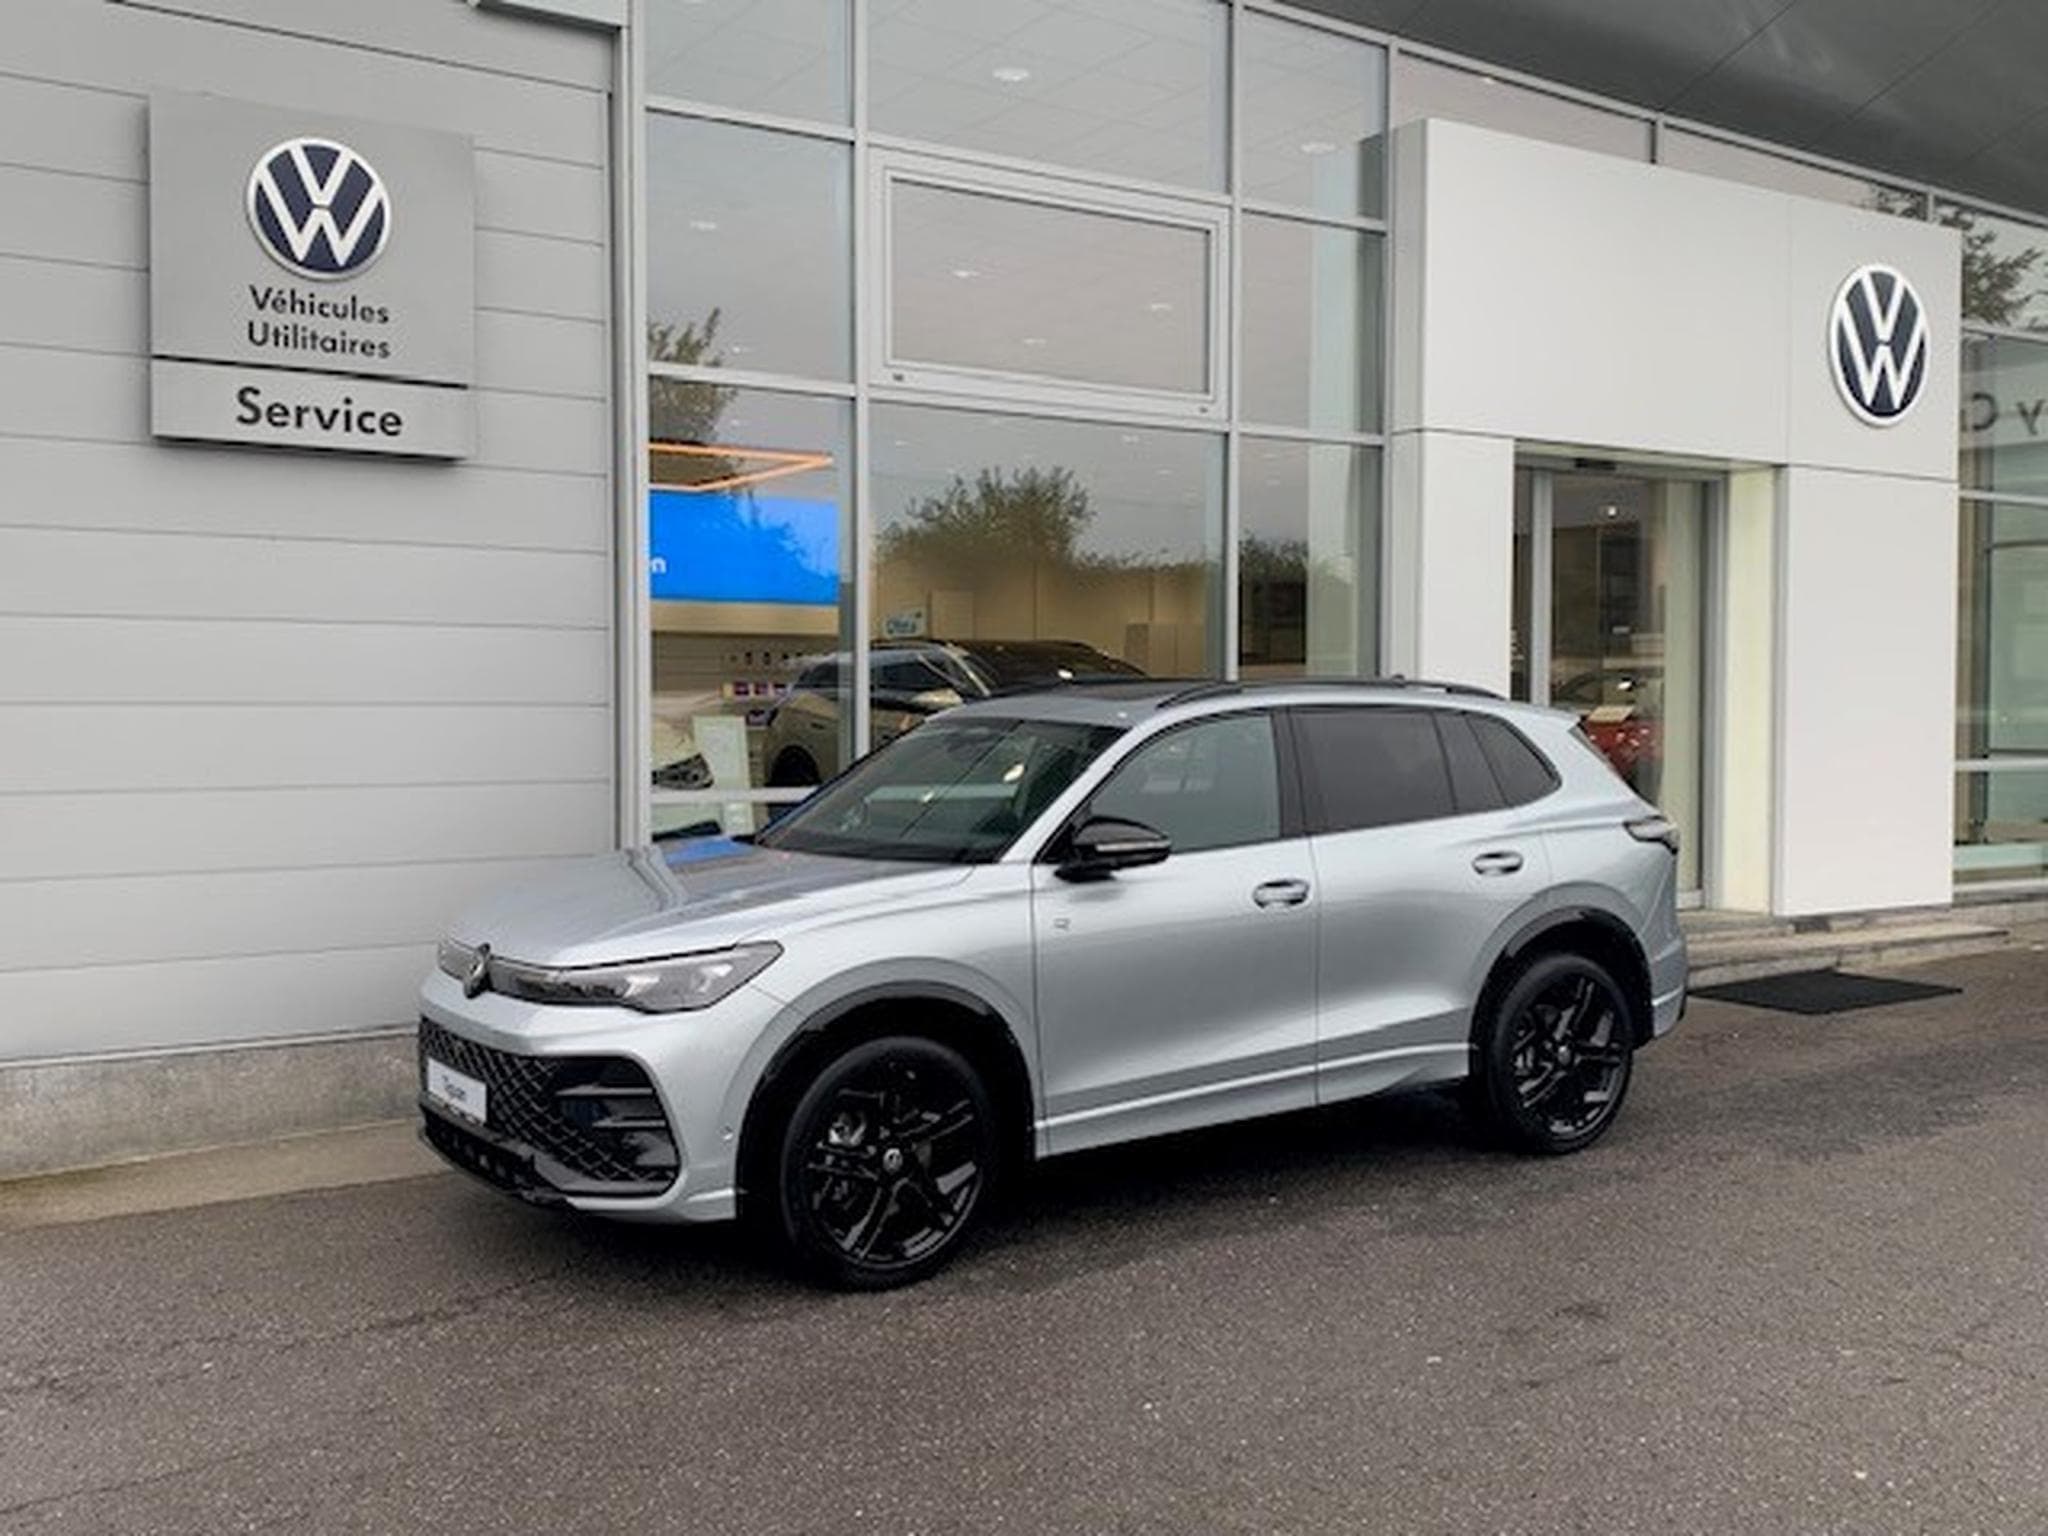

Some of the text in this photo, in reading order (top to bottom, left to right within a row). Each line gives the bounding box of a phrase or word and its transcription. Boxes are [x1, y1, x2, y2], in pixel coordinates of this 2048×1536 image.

[249, 285, 390, 324] Véhicules
[248, 321, 391, 359] Utilitaires
[236, 386, 403, 437] Service
